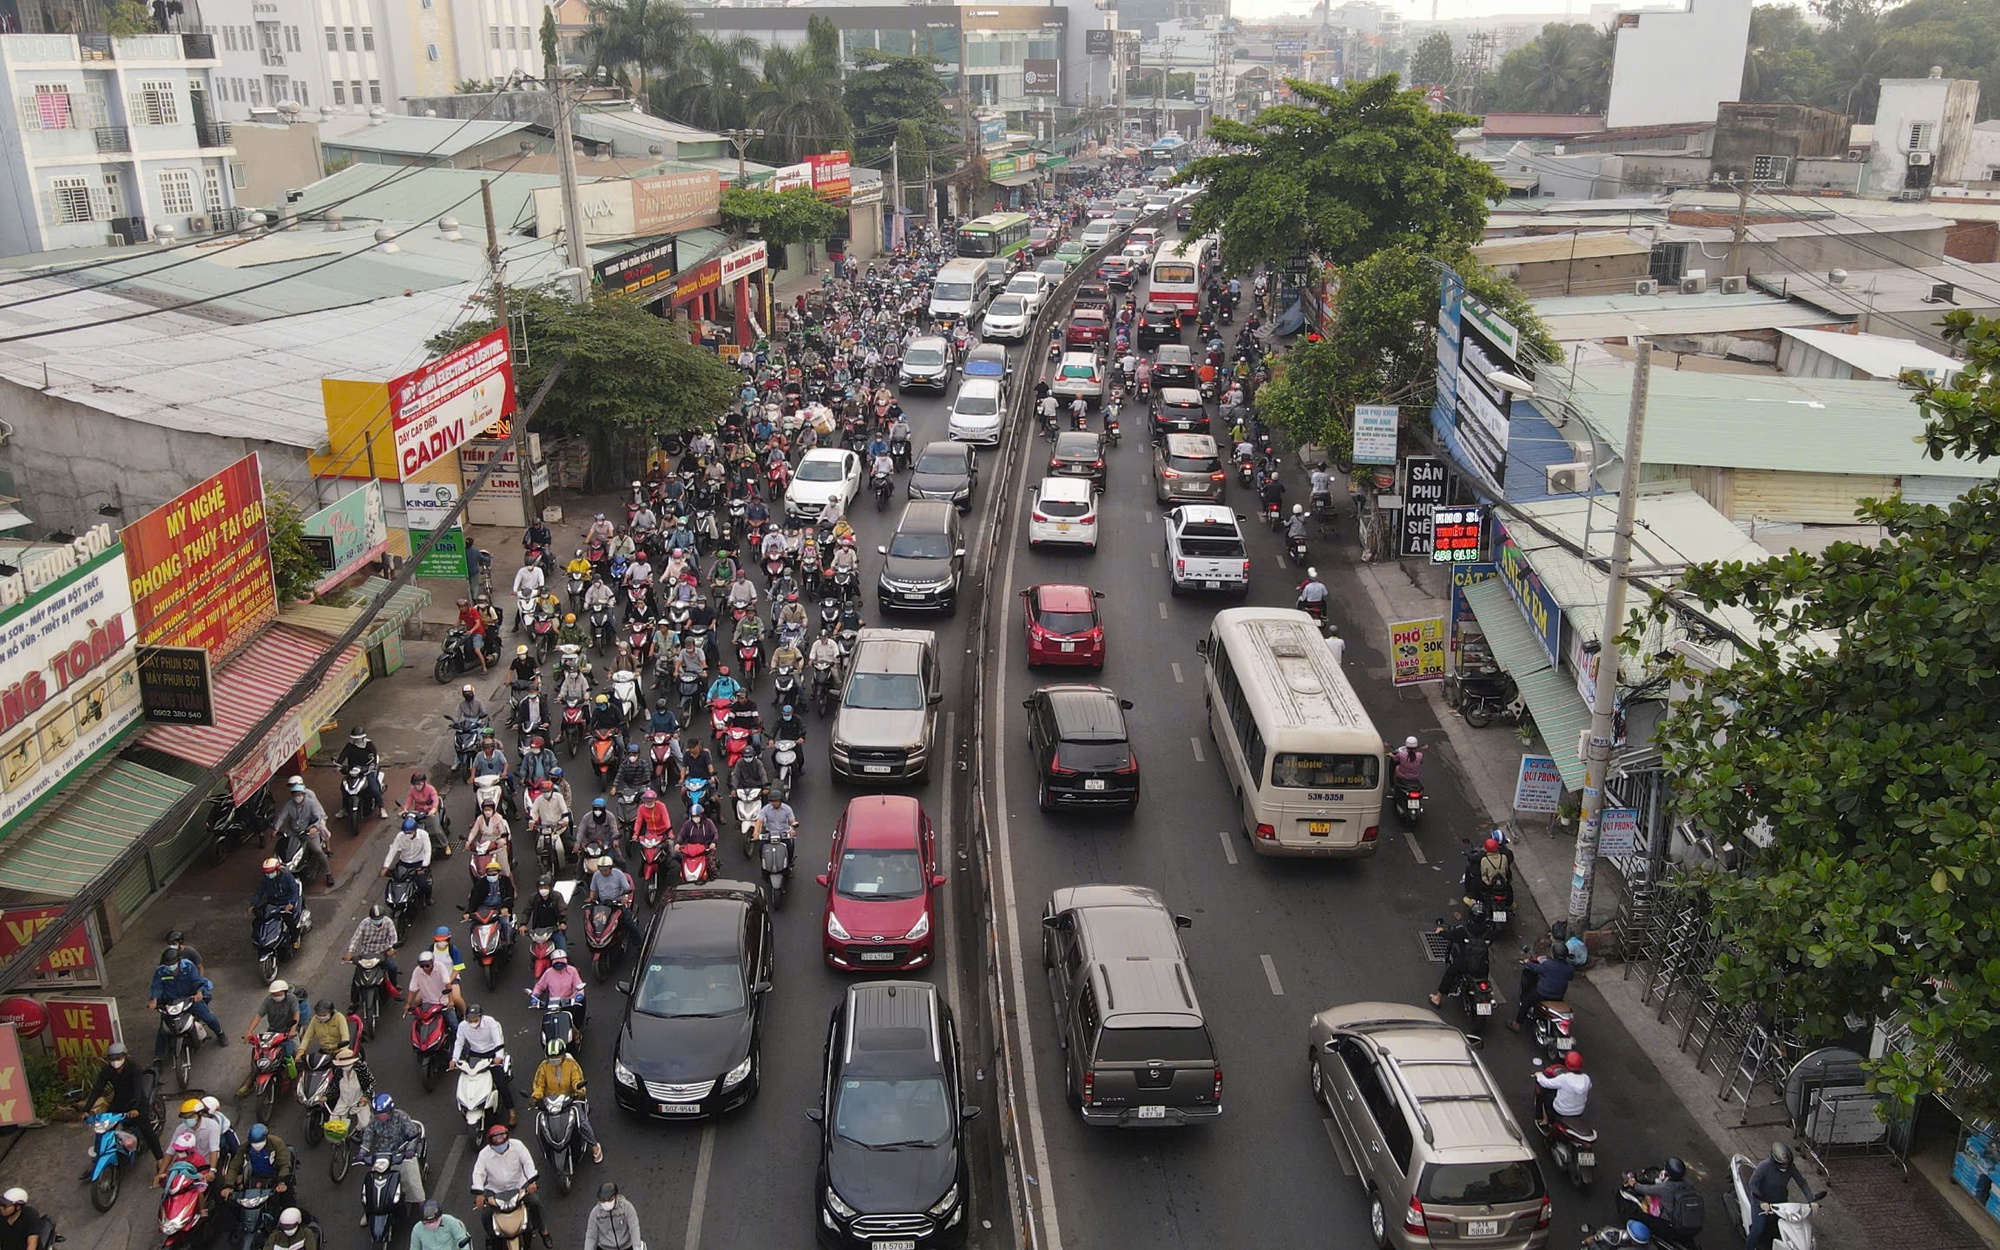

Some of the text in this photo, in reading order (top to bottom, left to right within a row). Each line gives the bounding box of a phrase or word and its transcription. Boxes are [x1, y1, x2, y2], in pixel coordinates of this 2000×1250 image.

[403, 418, 465, 475] CADIVI
[1413, 462, 1443, 481] SẢN
[491, 479, 520, 488] LINH
[1412, 485, 1442, 502] PHỤ
[166, 480, 226, 540] MỸ NGHỆ
[1435, 512, 1462, 524] KHO
[131, 500, 263, 602] PHONG THỦY TẠI GIA
[46, 594, 67, 618] PHUN
[70, 599, 89, 618] PHUN
[1393, 627, 1421, 645] PHỞ
[49, 612, 126, 687] TOÀN
[1423, 641, 1443, 653] 30K
[160, 656, 181, 671] PHUN
[1422, 665, 1443, 674] 30K
[163, 673, 184, 687] PHUN
[188, 710, 202, 719] 540
[275, 736, 301, 767] 20%
[1307, 793, 1344, 802] 53N-5358
[50, 946, 85, 968] BAY
[64, 1004, 96, 1031] VÉ
[57, 1033, 110, 1058] MÁY
